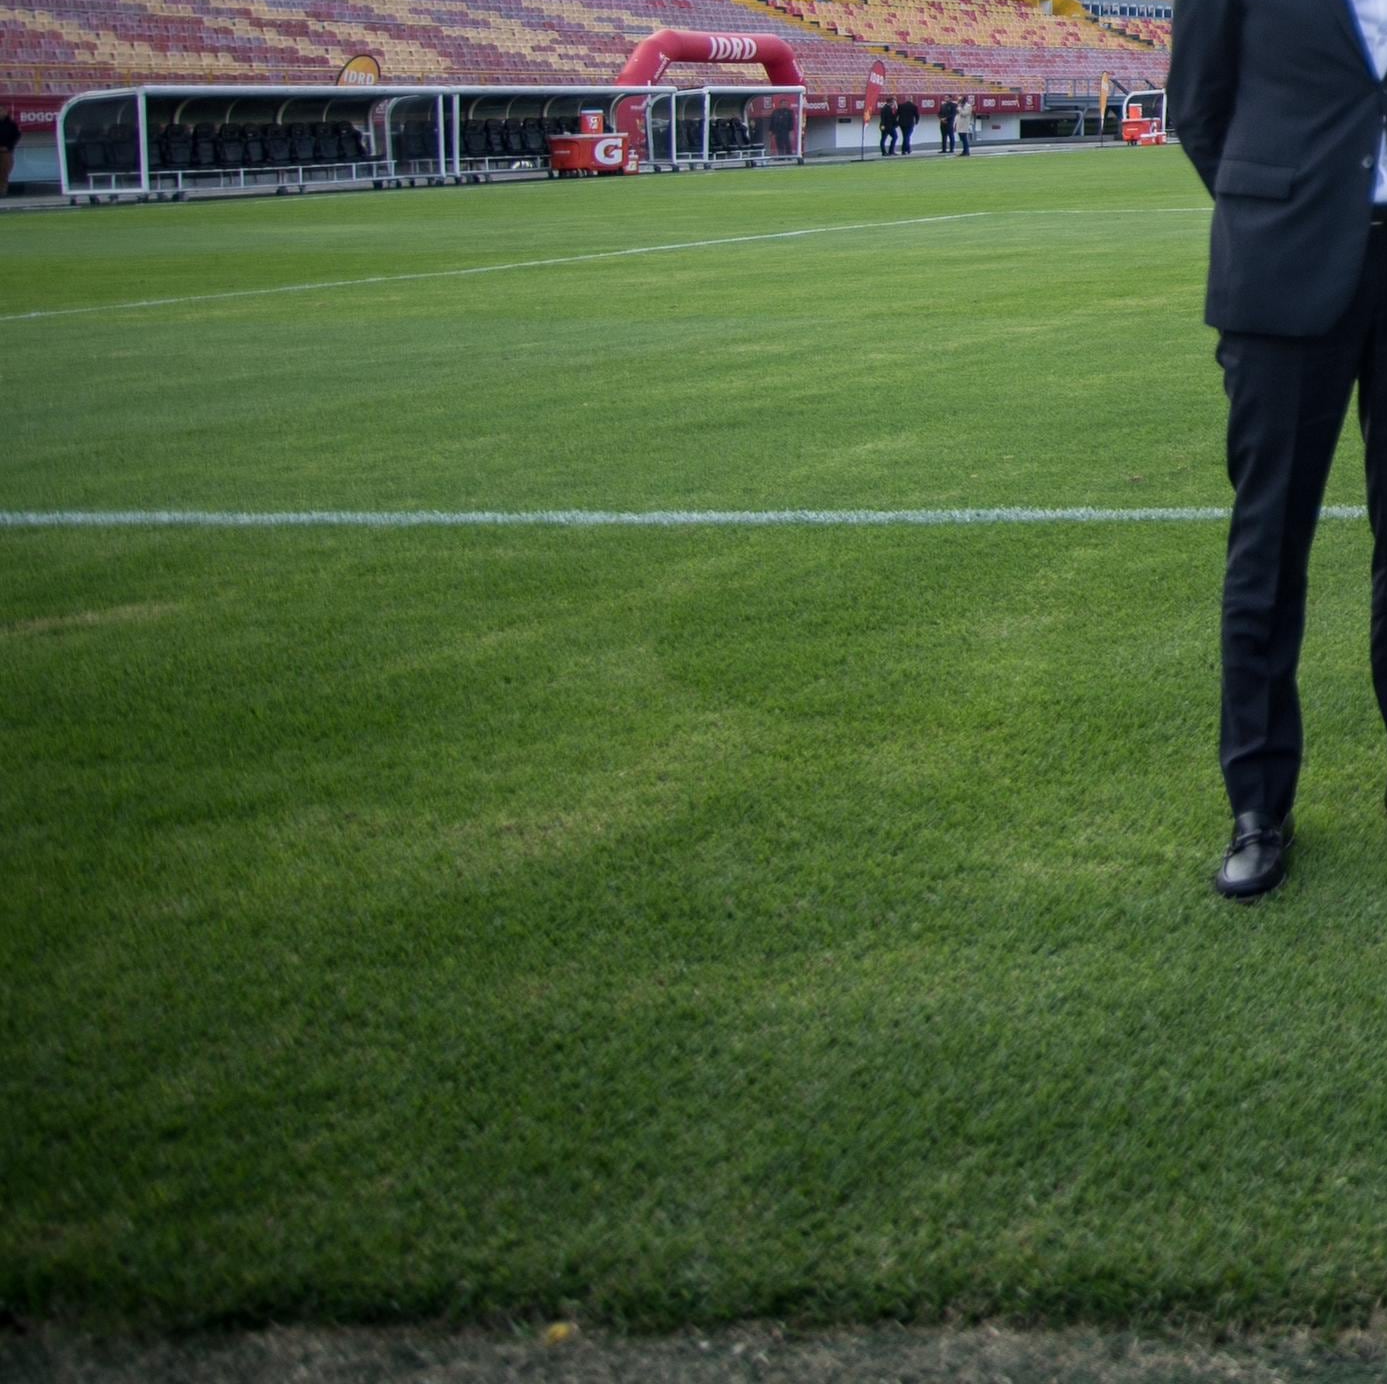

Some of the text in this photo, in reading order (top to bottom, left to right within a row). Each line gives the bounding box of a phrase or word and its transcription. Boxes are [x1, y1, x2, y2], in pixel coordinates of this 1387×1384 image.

[708, 36, 757, 61] IDRD
[344, 69, 375, 85] IDRD
[20, 111, 61, 122] BOGOT
[594, 138, 623, 165] G
